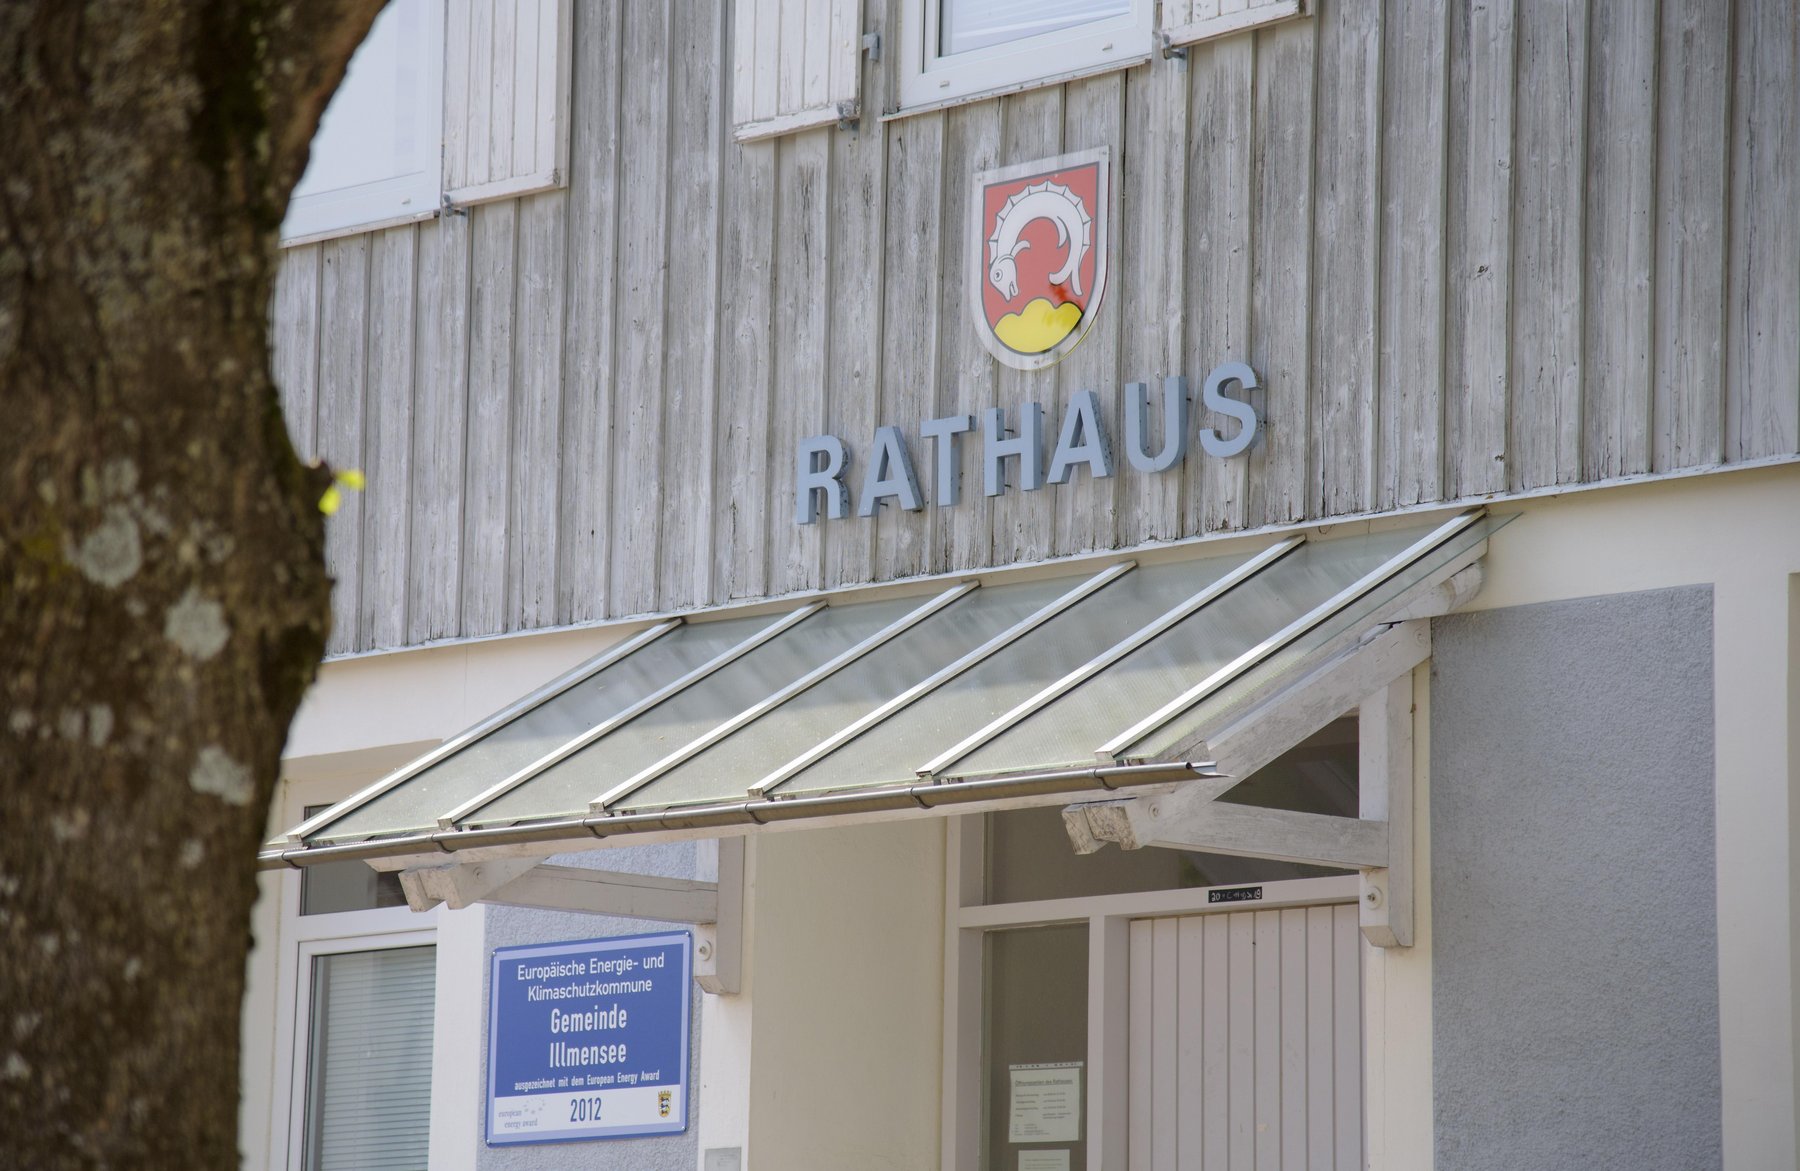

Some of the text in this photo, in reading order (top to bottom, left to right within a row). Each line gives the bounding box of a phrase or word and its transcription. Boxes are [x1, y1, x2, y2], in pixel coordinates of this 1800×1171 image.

[797, 362, 1263, 525] RATHAUS
[517, 952, 665, 982] Europäische Energie- und
[528, 979, 653, 1002] Klimaschutzkommune
[551, 1003, 628, 1034] Gemeinde
[550, 1042, 627, 1068] Illmensee
[514, 1070, 660, 1092] ausgezeichnet mit dem European Energy Award
[498, 1110, 522, 1118] european
[570, 1097, 602, 1122] 2012
